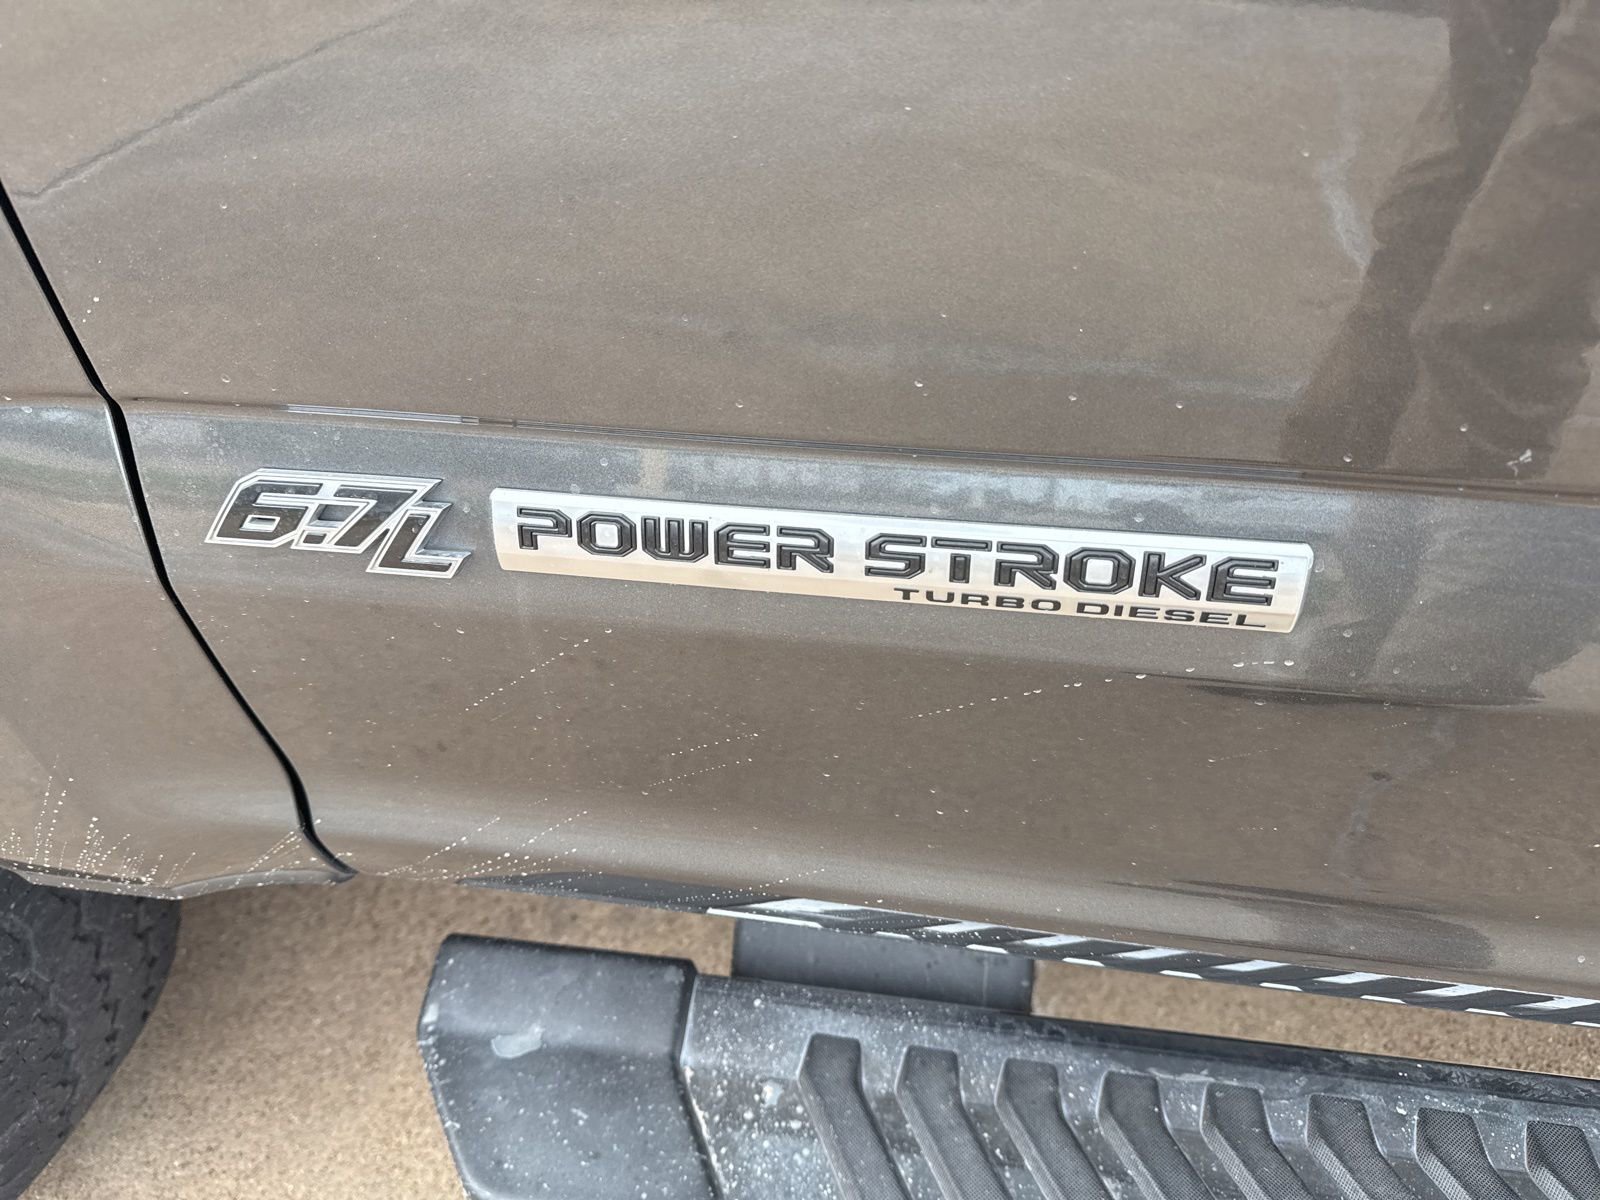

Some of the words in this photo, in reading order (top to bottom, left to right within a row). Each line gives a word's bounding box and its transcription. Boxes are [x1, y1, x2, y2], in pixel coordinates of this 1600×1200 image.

[516, 506, 835, 574] POWER
[864, 532, 1280, 607] STROKE
[893, 587, 1062, 612] TURBO
[1076, 602, 1267, 629] DIESEL
